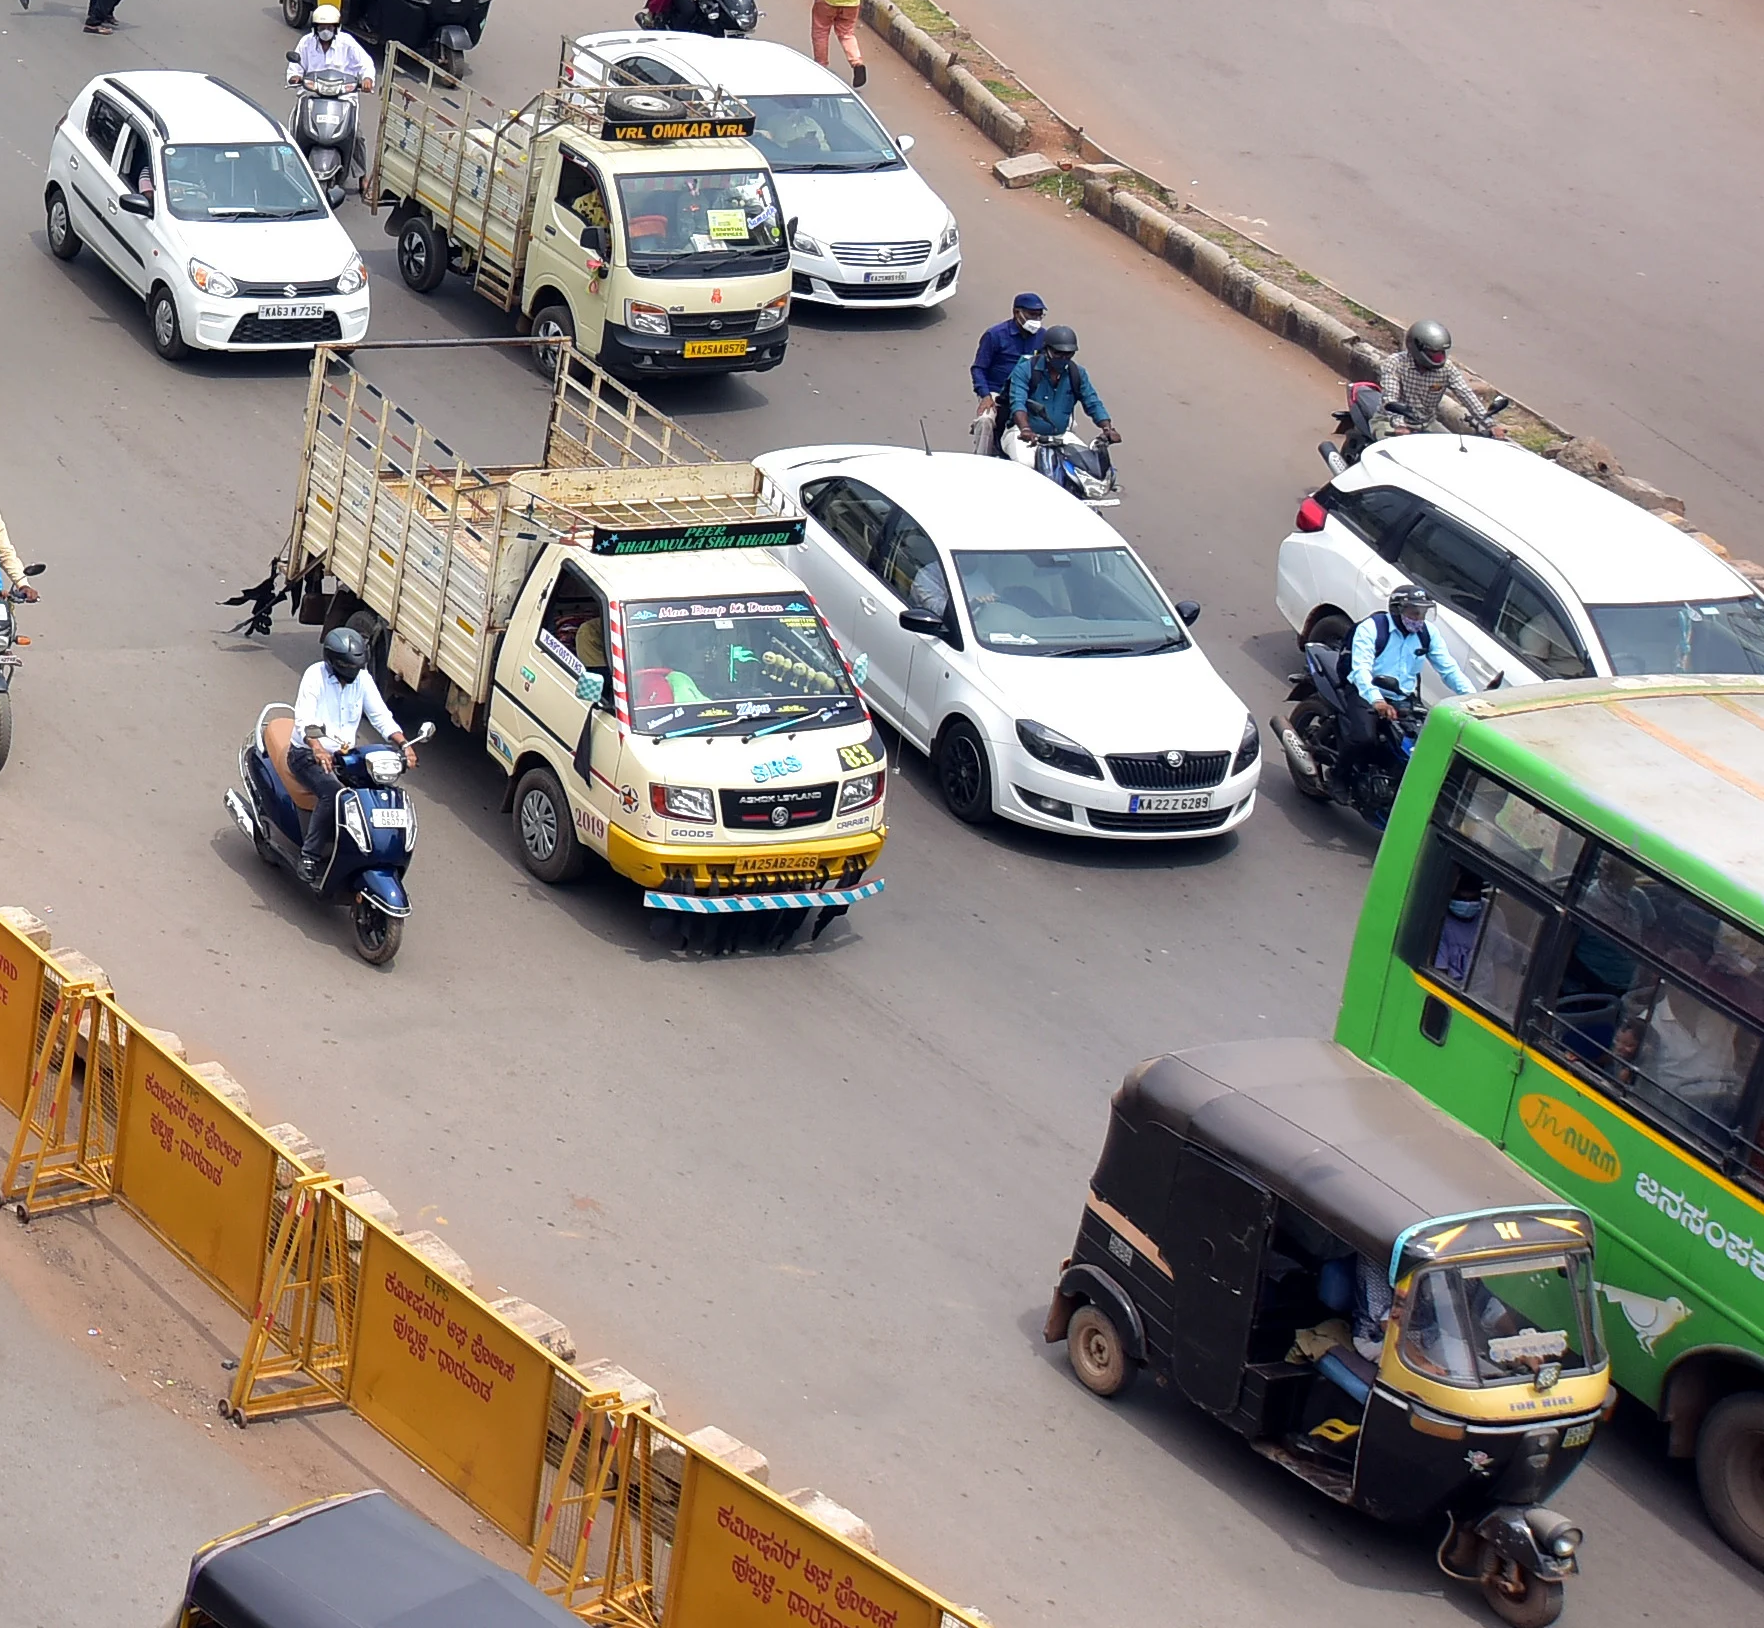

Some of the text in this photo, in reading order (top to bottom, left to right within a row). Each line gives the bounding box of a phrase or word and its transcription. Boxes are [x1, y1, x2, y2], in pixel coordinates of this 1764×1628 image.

[615, 123, 746, 140] VRL OMKAR VRL
[265, 306, 323, 317] KA63 M 7256
[690, 342, 745, 356] KA25AA8578
[683, 525, 725, 538] PEER
[614, 531, 791, 554] KHALIMULLA SHA KHADRI
[840, 746, 874, 768] 83
[739, 790, 822, 804] ASHOK LEYLAND
[1137, 795, 1209, 810] KA 22 Z 6289
[575, 808, 605, 839] 2019
[836, 815, 870, 830] CARRIER
[670, 829, 715, 839] GOODS
[740, 855, 817, 871] KA25AB2466
